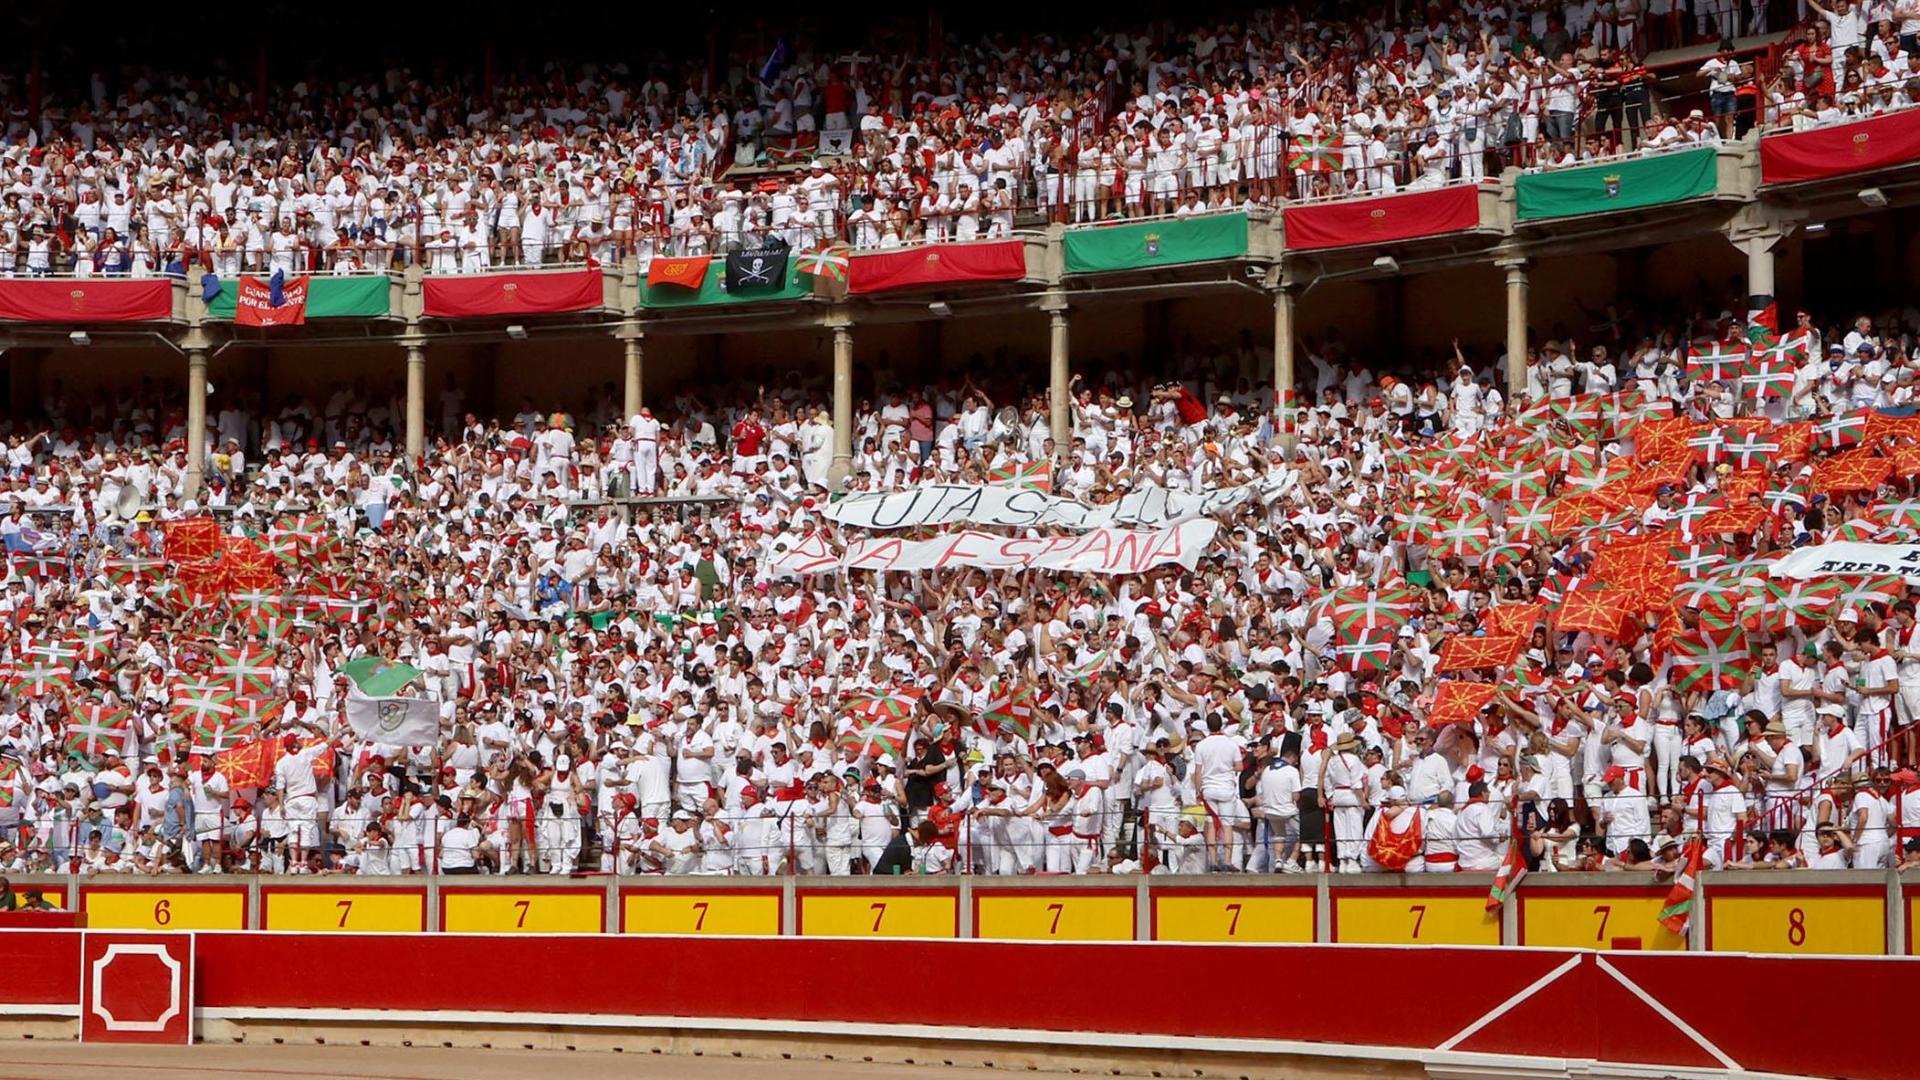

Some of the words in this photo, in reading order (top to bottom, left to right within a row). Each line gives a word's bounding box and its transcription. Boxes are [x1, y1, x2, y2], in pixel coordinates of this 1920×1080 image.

[154, 899, 171, 926] 6
[336, 900, 353, 928] 7
[514, 900, 531, 928] 7
[692, 902, 709, 931] 7
[870, 902, 887, 933] 7
[1047, 903, 1064, 935] 7
[1225, 903, 1242, 936] 7
[1408, 904, 1427, 939] 7
[1593, 906, 1612, 942] 7
[1787, 909, 1807, 947] 8
